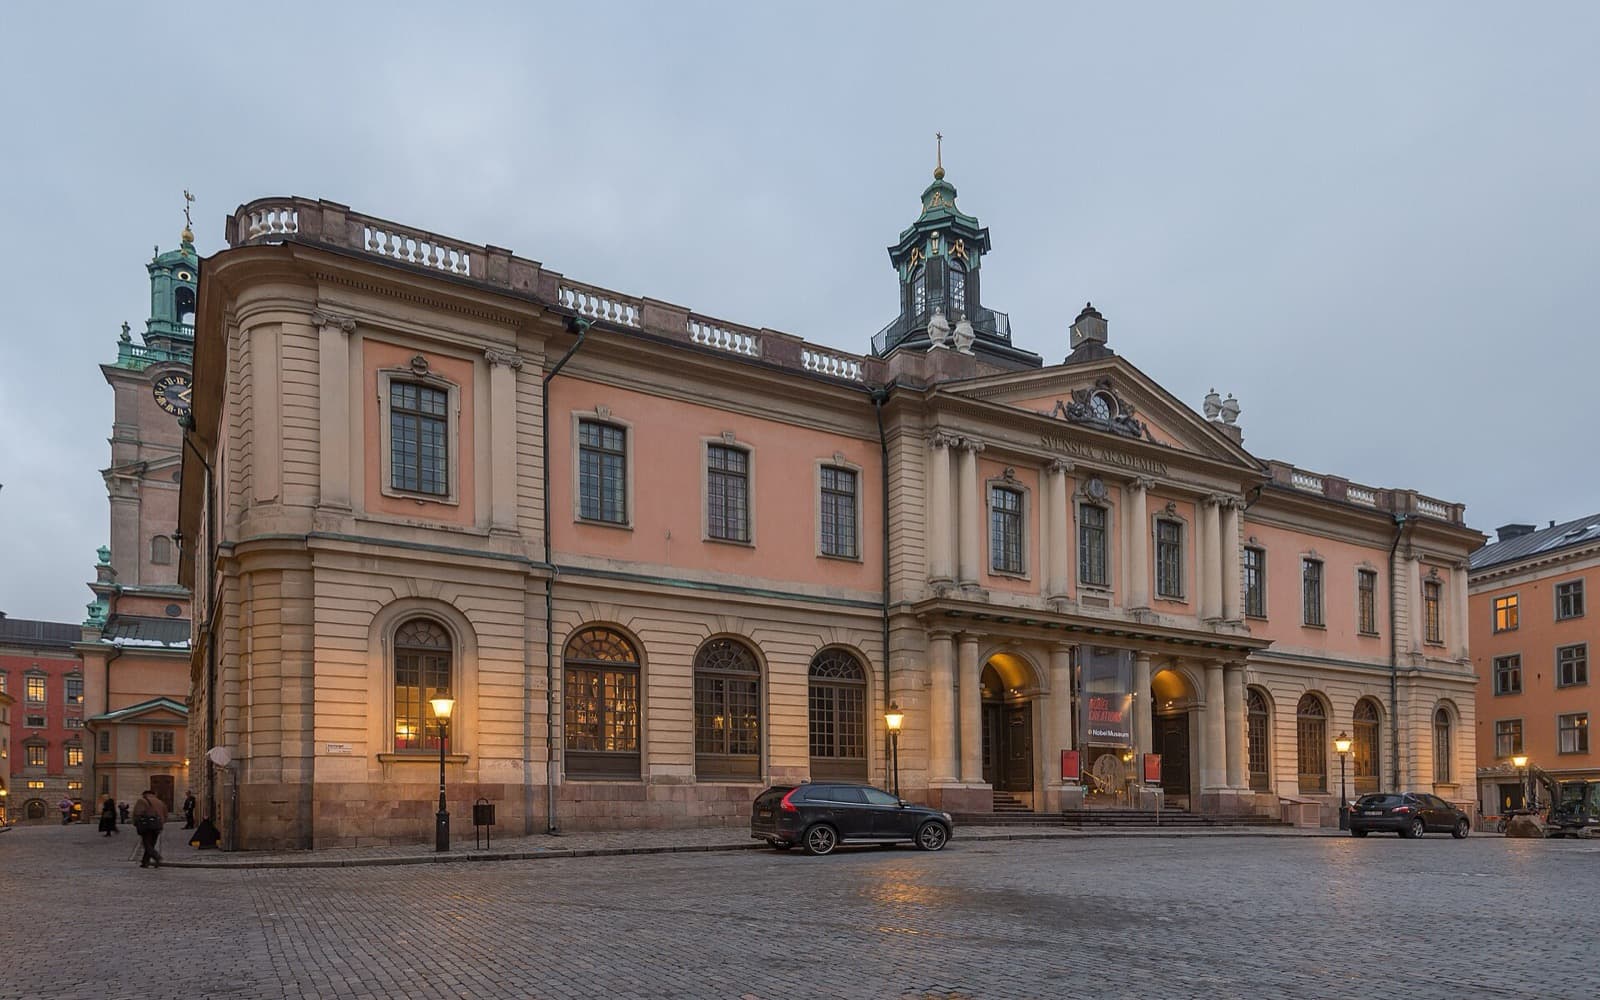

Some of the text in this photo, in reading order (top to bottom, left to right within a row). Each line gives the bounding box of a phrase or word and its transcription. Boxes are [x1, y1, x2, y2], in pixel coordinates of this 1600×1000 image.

[1040, 434, 1169, 474] SVENSKA AKADEMIEN
[1093, 729, 1129, 738] Nobel Museum
